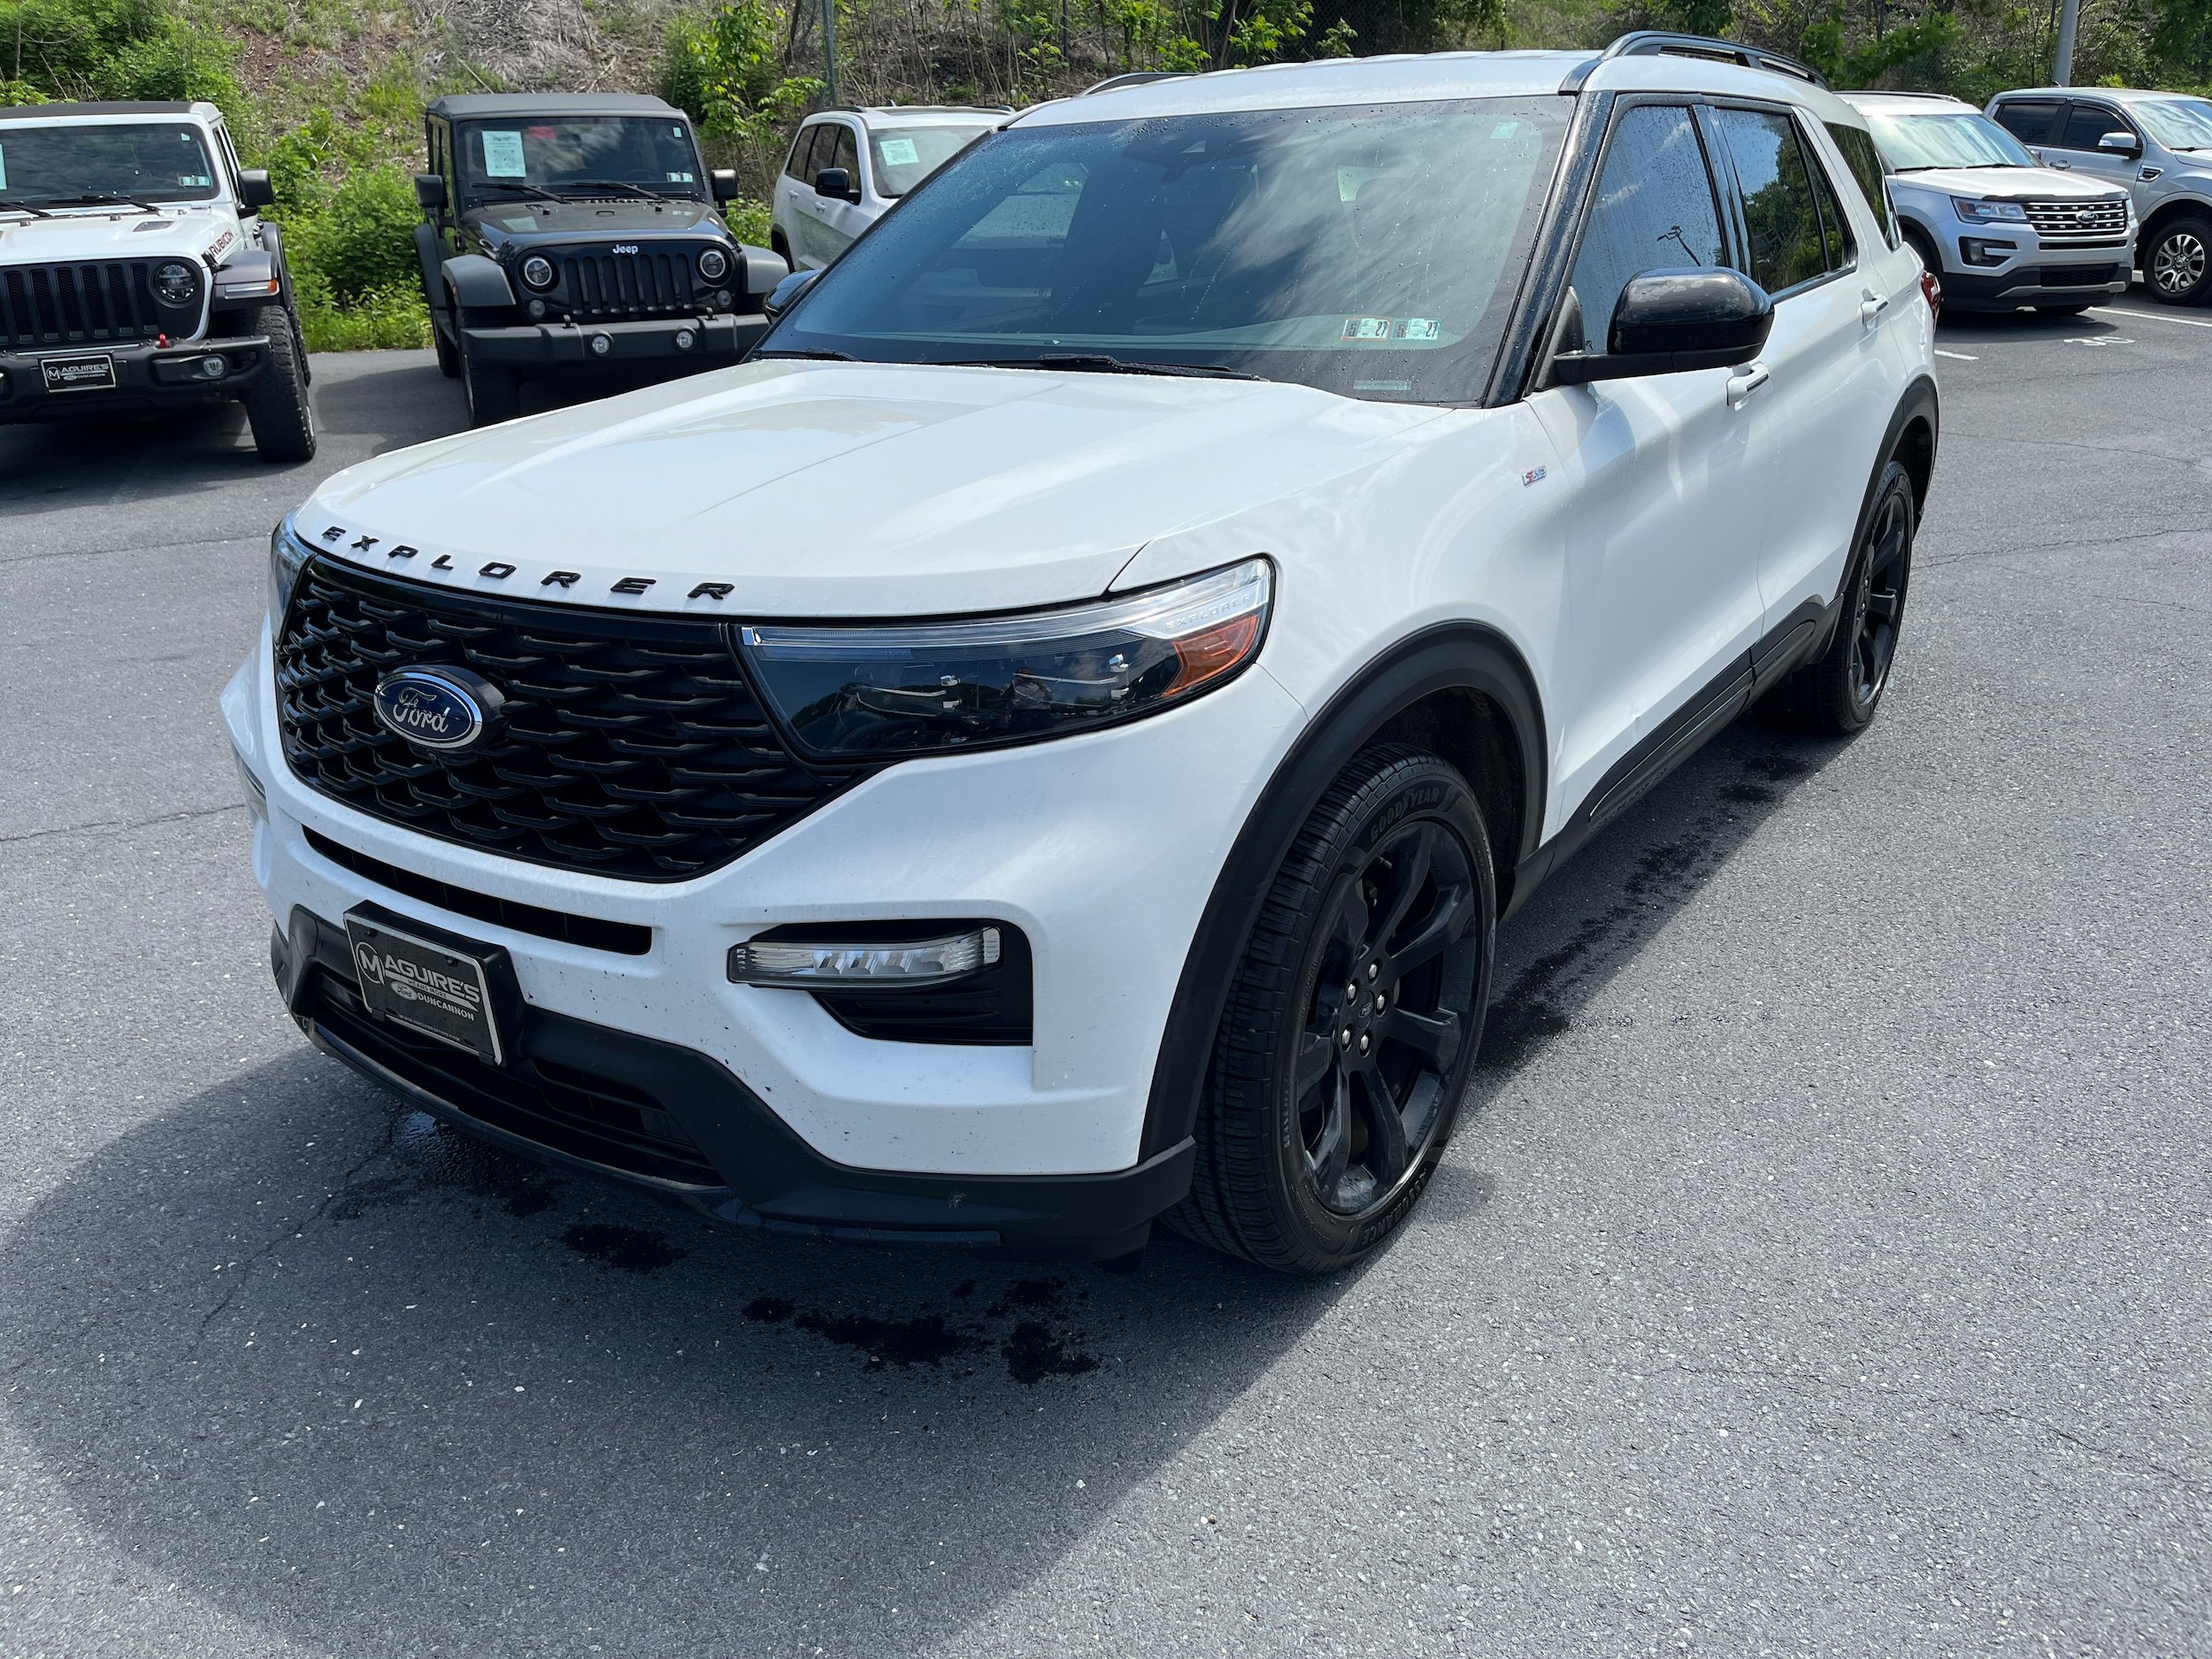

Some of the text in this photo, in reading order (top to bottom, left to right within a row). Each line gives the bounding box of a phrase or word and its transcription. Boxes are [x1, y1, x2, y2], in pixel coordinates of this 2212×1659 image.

[208, 228, 234, 257] RUBICON
[612, 244, 639, 255] Jeep
[1348, 320, 1388, 337] 5 27
[1425, 321, 1439, 338] 27
[321, 526, 735, 601] EXPLORER
[1165, 595, 1251, 630] EXPLORER
[393, 687, 451, 734] Ford
[1371, 787, 1440, 843] GOODYEAR
[407, 979, 447, 998] MEANS MORE
[417, 992, 475, 1022] DUNCANNON
[1362, 1167, 1428, 1245] ASSURANCE
